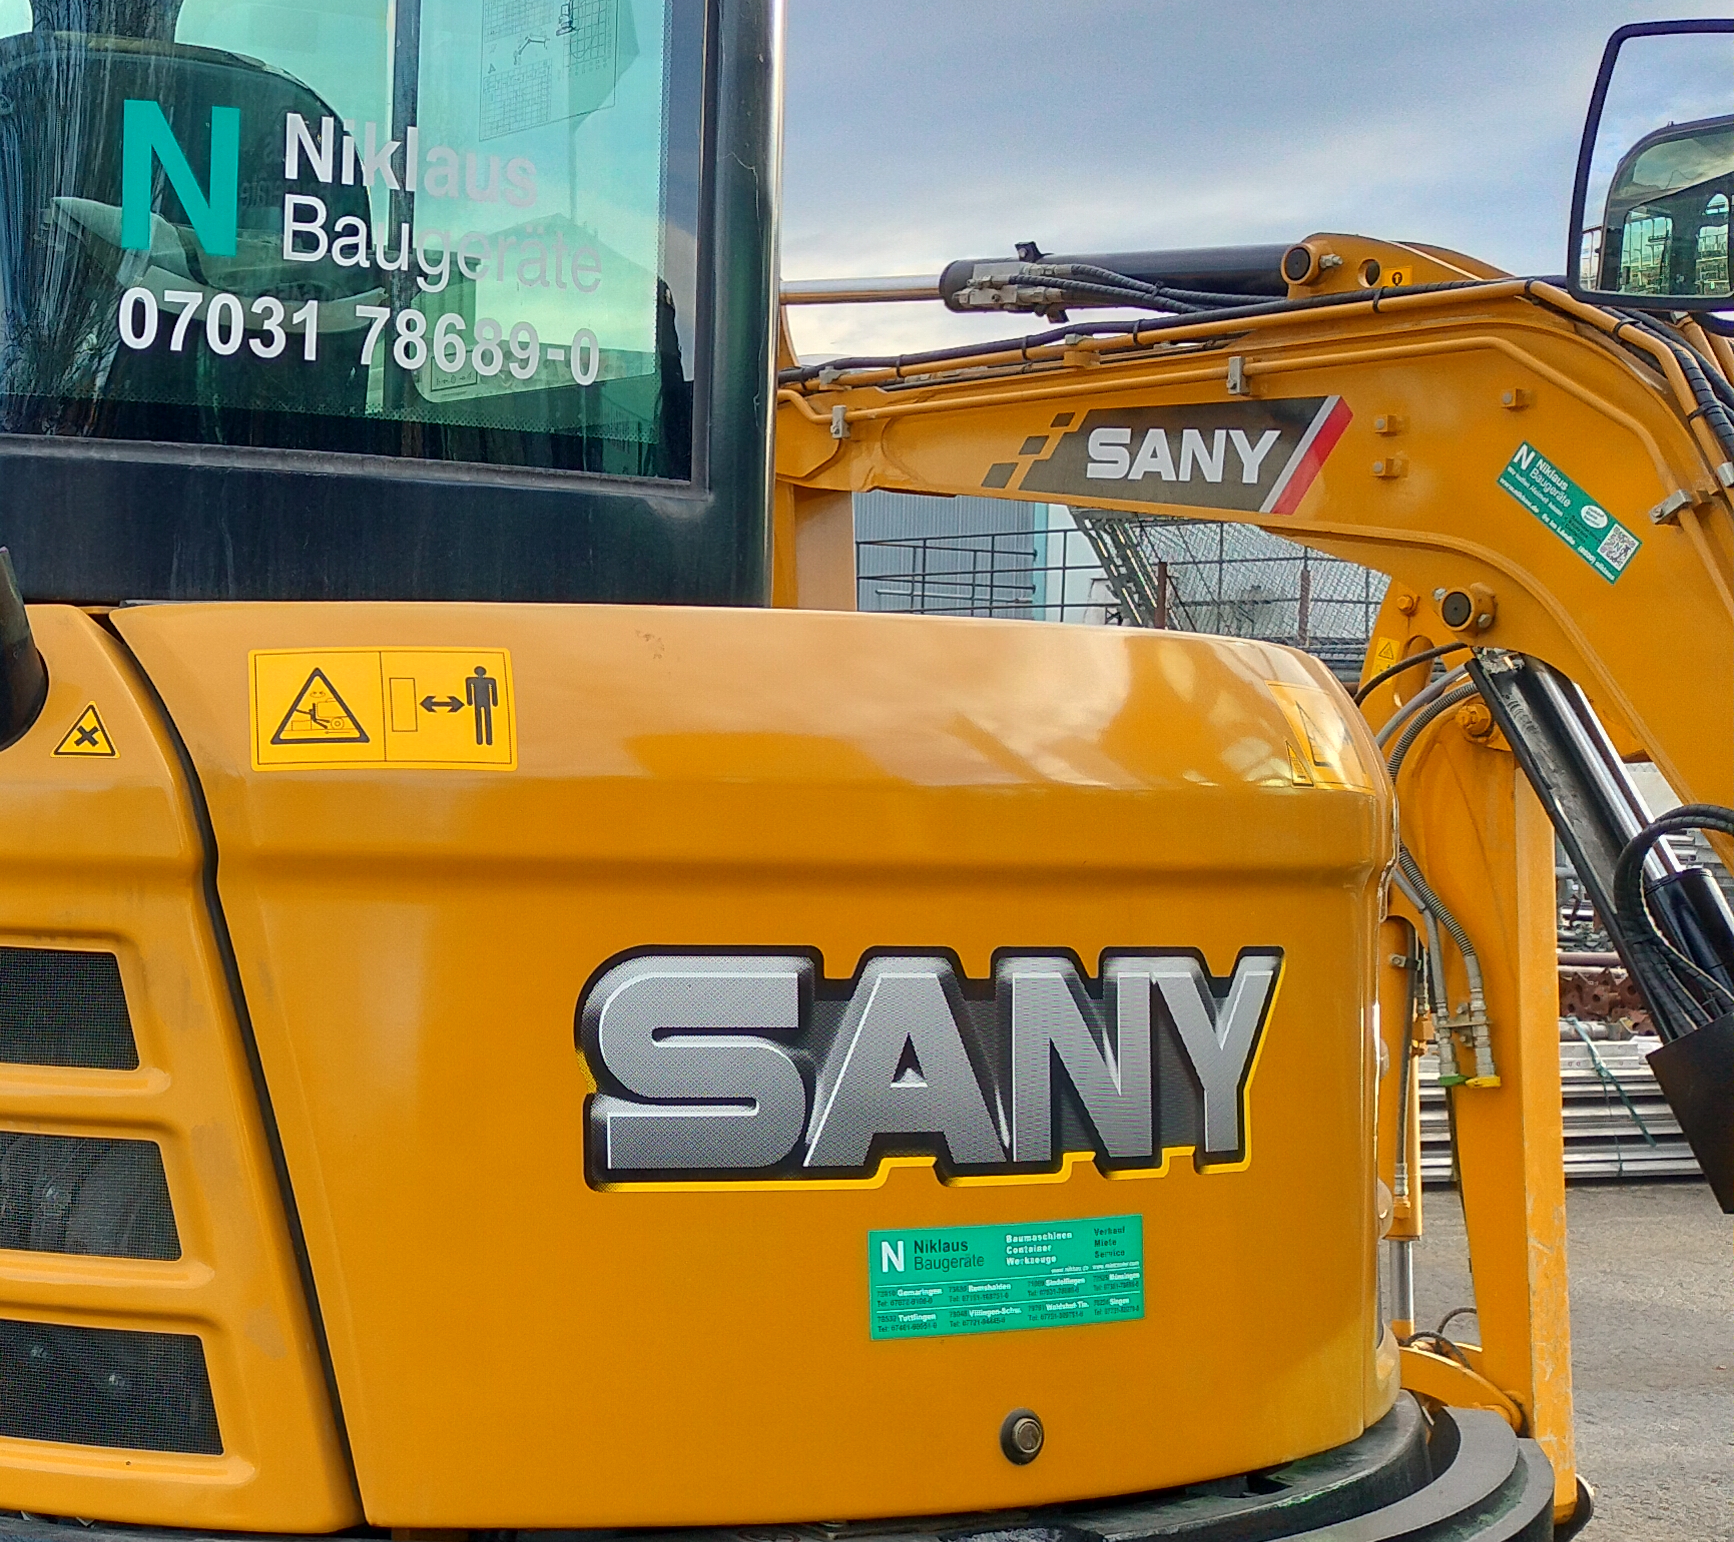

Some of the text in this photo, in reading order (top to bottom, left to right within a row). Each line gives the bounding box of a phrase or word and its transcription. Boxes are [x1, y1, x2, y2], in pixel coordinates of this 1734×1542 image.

[120, 99, 240, 256] N
[284, 112, 538, 208] Niklaus
[282, 193, 602, 293] Baugeräte
[117, 287, 319, 362] 07031
[357, 306, 600, 386] 78689-0
[1086, 427, 1282, 484] SANY
[1536, 459, 1568, 490] Niklaus
[578, 946, 1283, 1188] SANY
[881, 1240, 905, 1273] N
[914, 1239, 968, 1254] Niklaus
